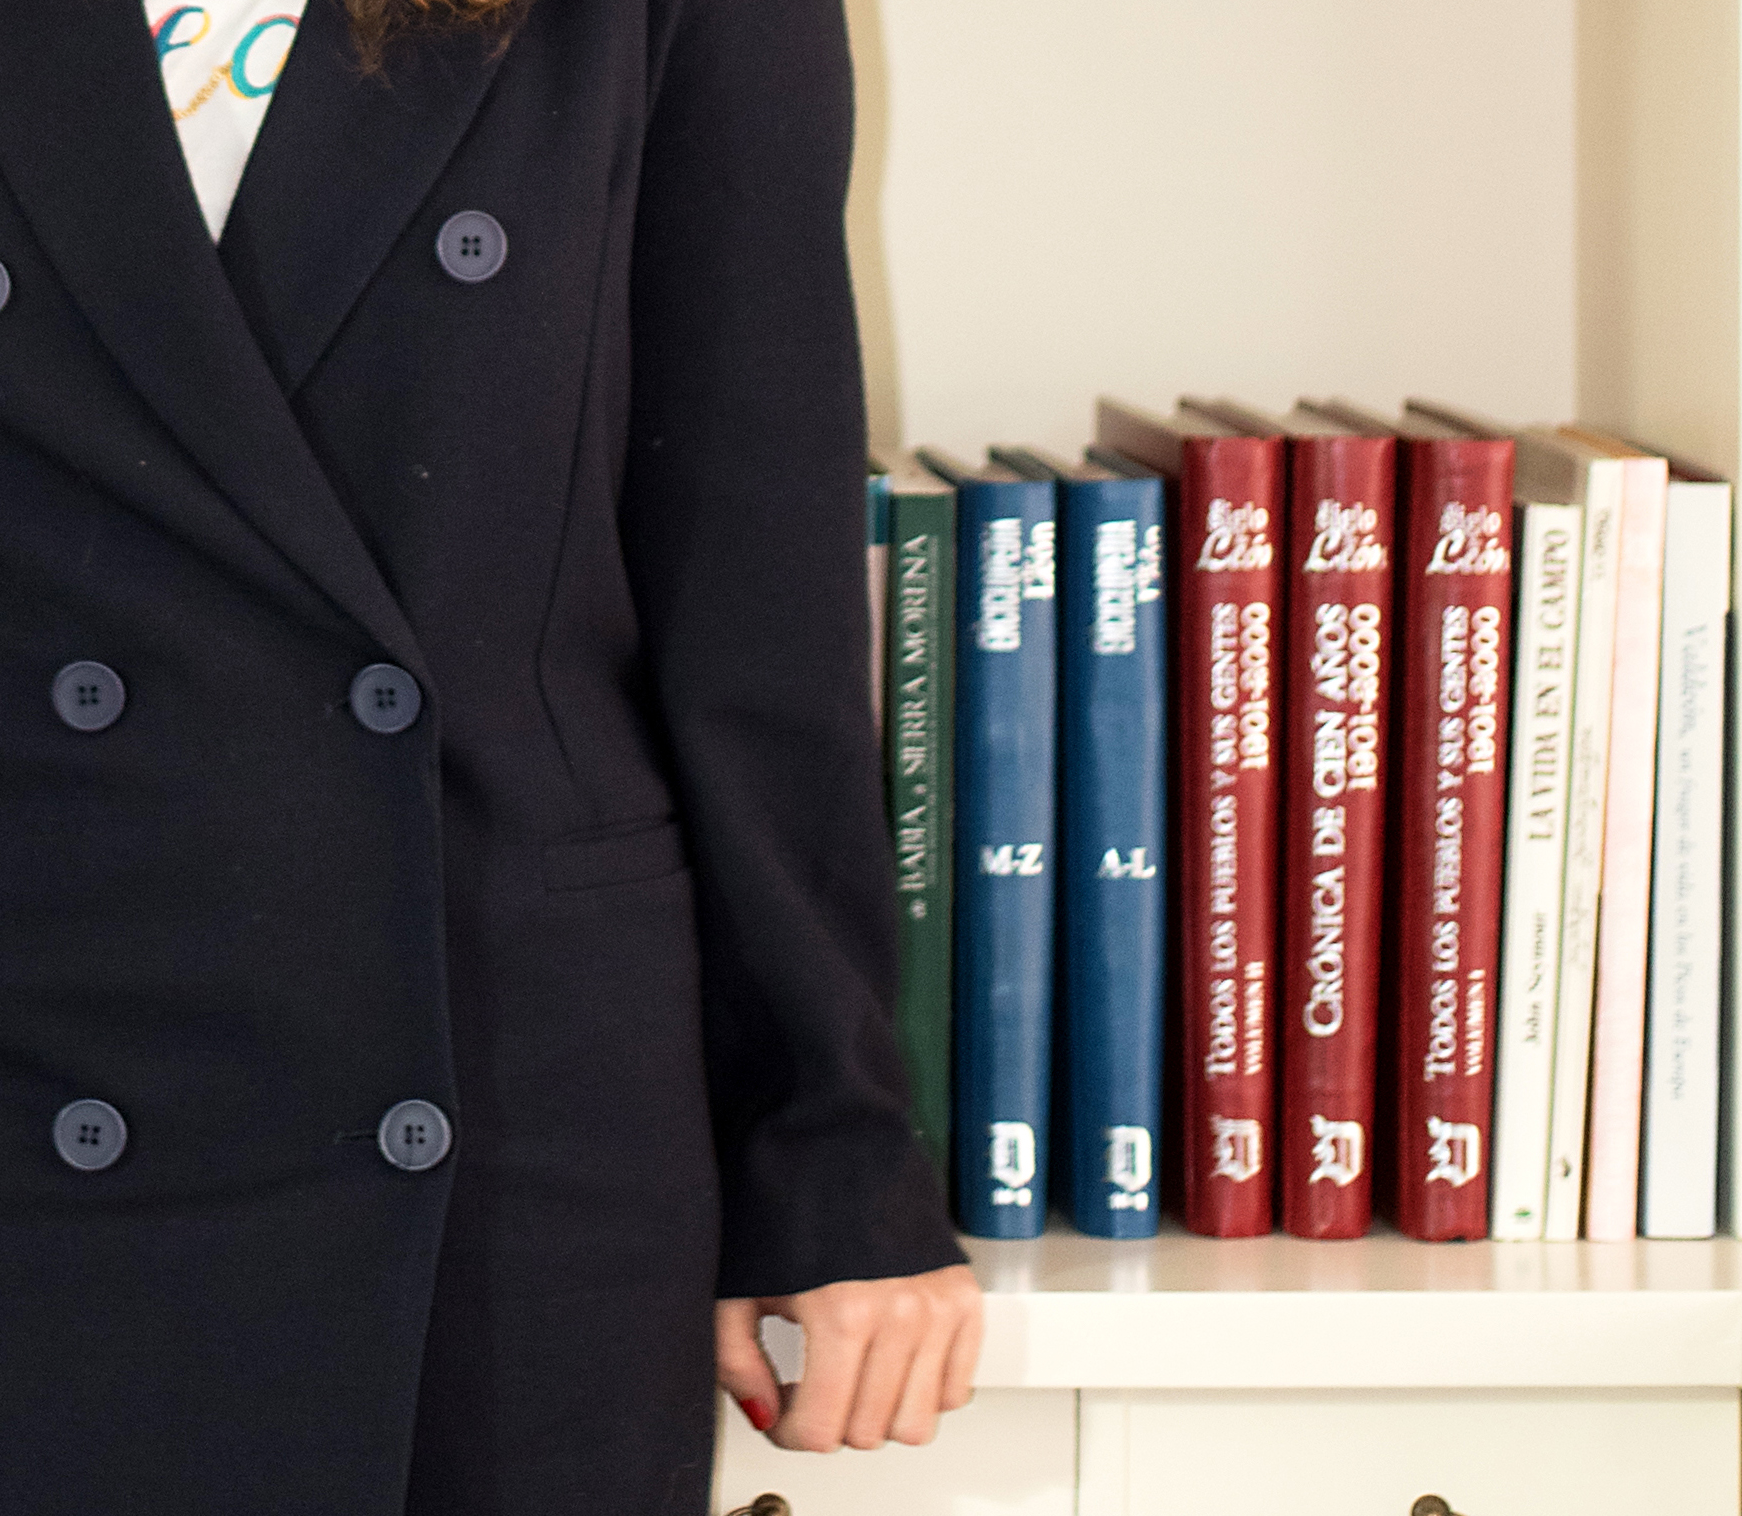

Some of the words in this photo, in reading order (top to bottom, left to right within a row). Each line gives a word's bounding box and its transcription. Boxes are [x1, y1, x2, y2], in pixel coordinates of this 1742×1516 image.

[899, 531, 929, 665] MORENA
[1539, 528, 1570, 630] CAMPO
[1210, 602, 1240, 709] GENTES
[1239, 602, 1272, 771] 1901-2000
[1308, 602, 1350, 701] AÑOS
[1437, 604, 1470, 714] GENTES
[1467, 604, 1501, 776] 1901-2000
[1537, 639, 1566, 671] EL
[899, 672, 929, 775] SIERRA
[1210, 713, 1239, 766] SUS
[1347, 602, 1383, 791] 1901-2000
[1536, 680, 1564, 718] EN
[1210, 769, 1239, 788] Y
[1313, 711, 1348, 797] CIEN
[1436, 716, 1467, 767] SUS
[1436, 770, 1465, 790] Y
[1531, 729, 1561, 797] VIDA
[898, 805, 929, 892] BABIA
[979, 842, 1044, 876] M-Z
[1097, 846, 1157, 880] A-L
[1208, 795, 1240, 915] PUEBLOS
[1312, 806, 1347, 856] DE
[1431, 796, 1465, 915] PUEBLOS
[1529, 804, 1556, 841] LA
[1208, 920, 1239, 971] LOS
[1302, 865, 1348, 1037] CRÓNICA
[1430, 920, 1461, 973] LOS
[1528, 910, 1552, 994] Seymour
[1204, 979, 1240, 1080] TODOS
[1244, 985, 1267, 1076] VOLUMEN
[1423, 979, 1459, 1082] TODOS
[1465, 985, 1487, 1077] VOLUMEN
[1522, 998, 1544, 1048] John
